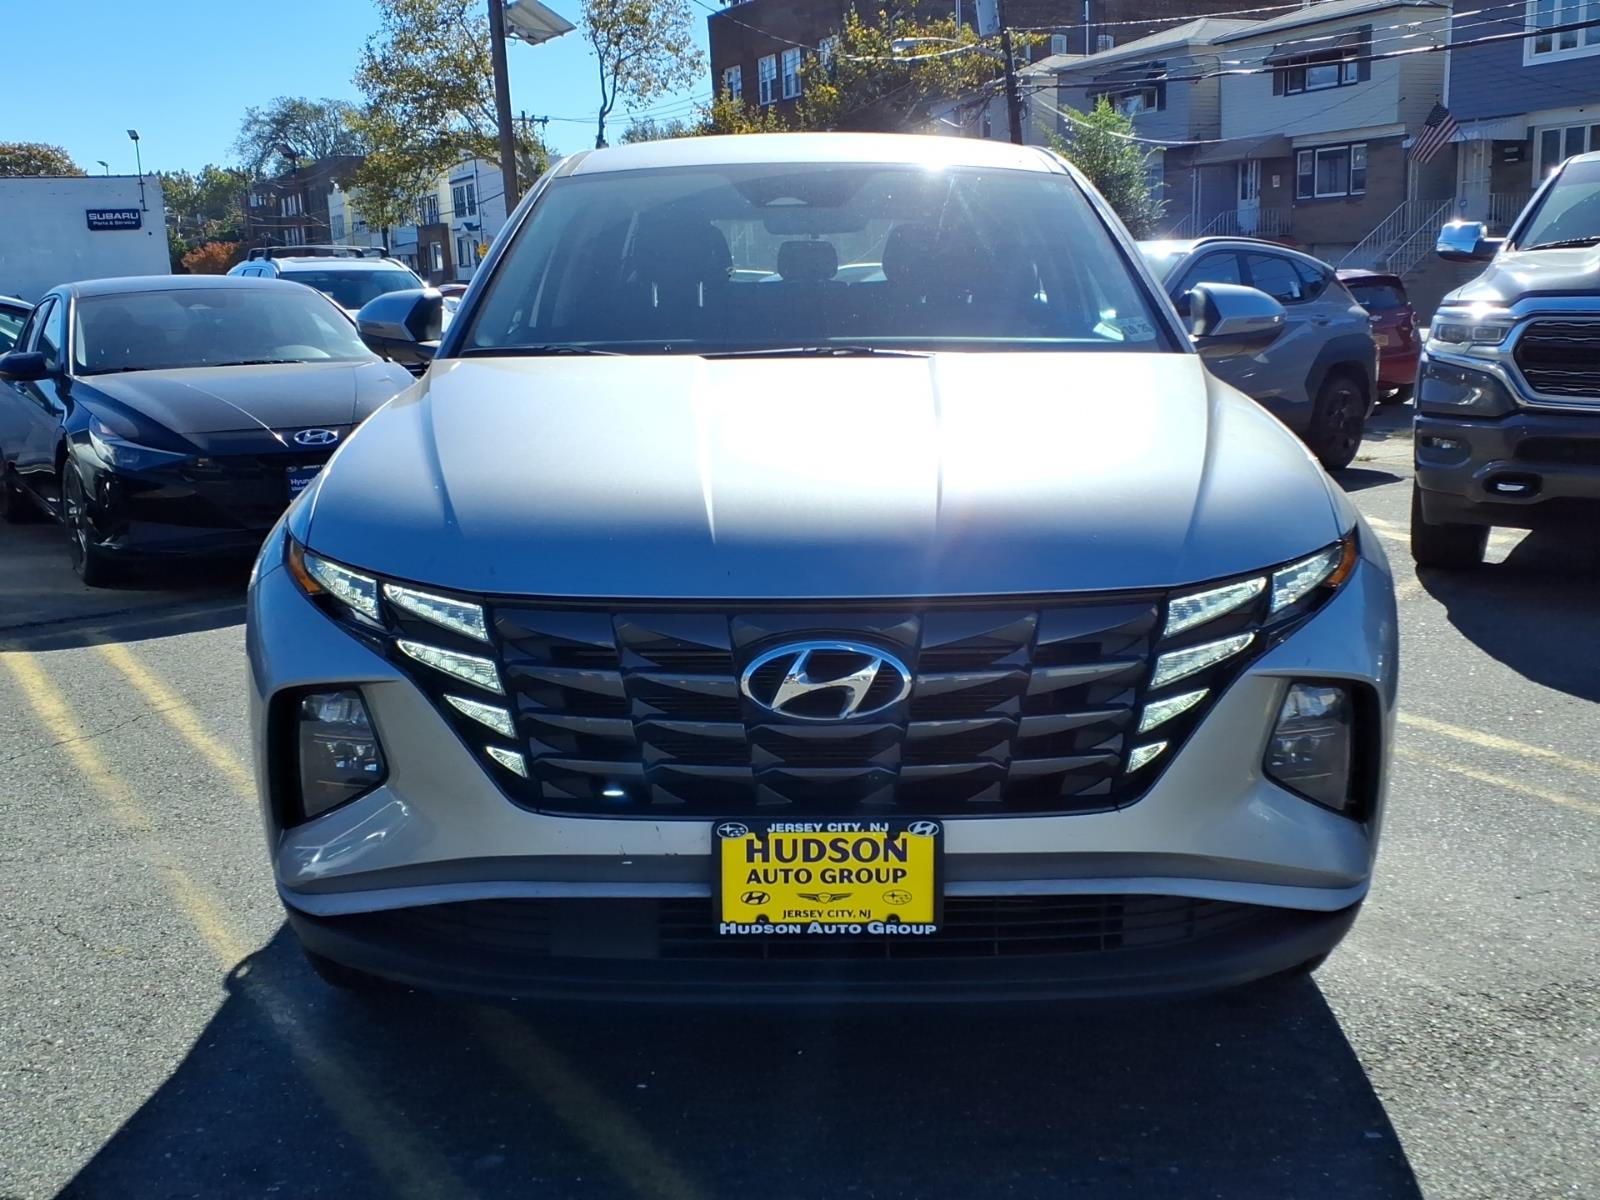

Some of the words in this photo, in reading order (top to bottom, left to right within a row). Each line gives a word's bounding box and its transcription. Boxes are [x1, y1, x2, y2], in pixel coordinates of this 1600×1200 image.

[88, 212, 138, 220] SUBARU
[767, 822, 823, 833] JERSEY
[869, 822, 890, 832] NJ
[746, 837, 908, 864] HUDSON
[746, 868, 813, 884] AUTO
[819, 868, 907, 884] GROUP
[783, 909, 824, 919] JERSEY
[858, 909, 871, 919] NJ
[719, 922, 801, 935] HUDSON
[807, 921, 862, 935] AUTO
[867, 921, 937, 935] GROUP
